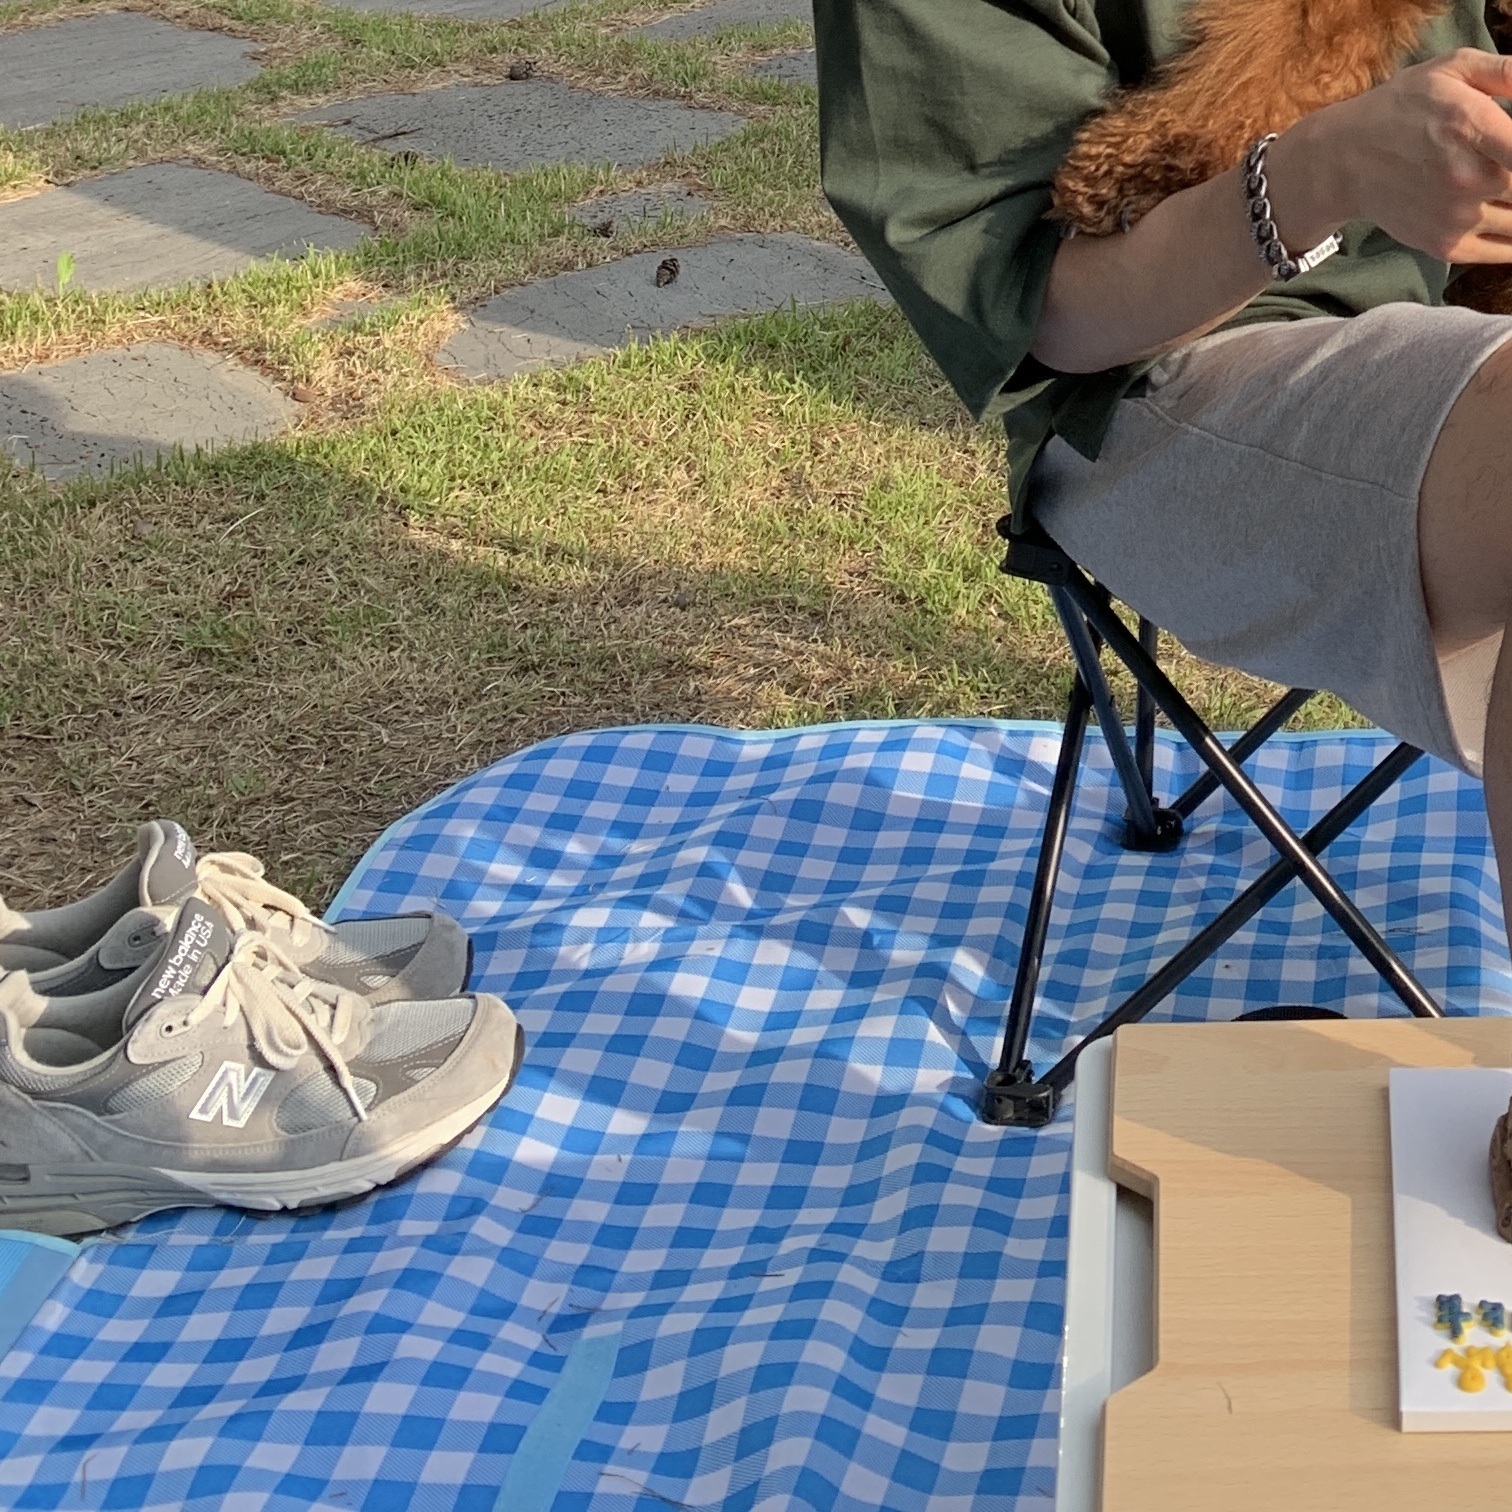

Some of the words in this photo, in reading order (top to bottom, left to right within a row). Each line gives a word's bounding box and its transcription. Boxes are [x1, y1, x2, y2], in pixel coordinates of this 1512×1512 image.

[151, 965, 177, 1000] new
[169, 912, 204, 965] balance
[187, 948, 201, 963] in
[195, 919, 214, 948] USA
[189, 1060, 276, 1128] N
